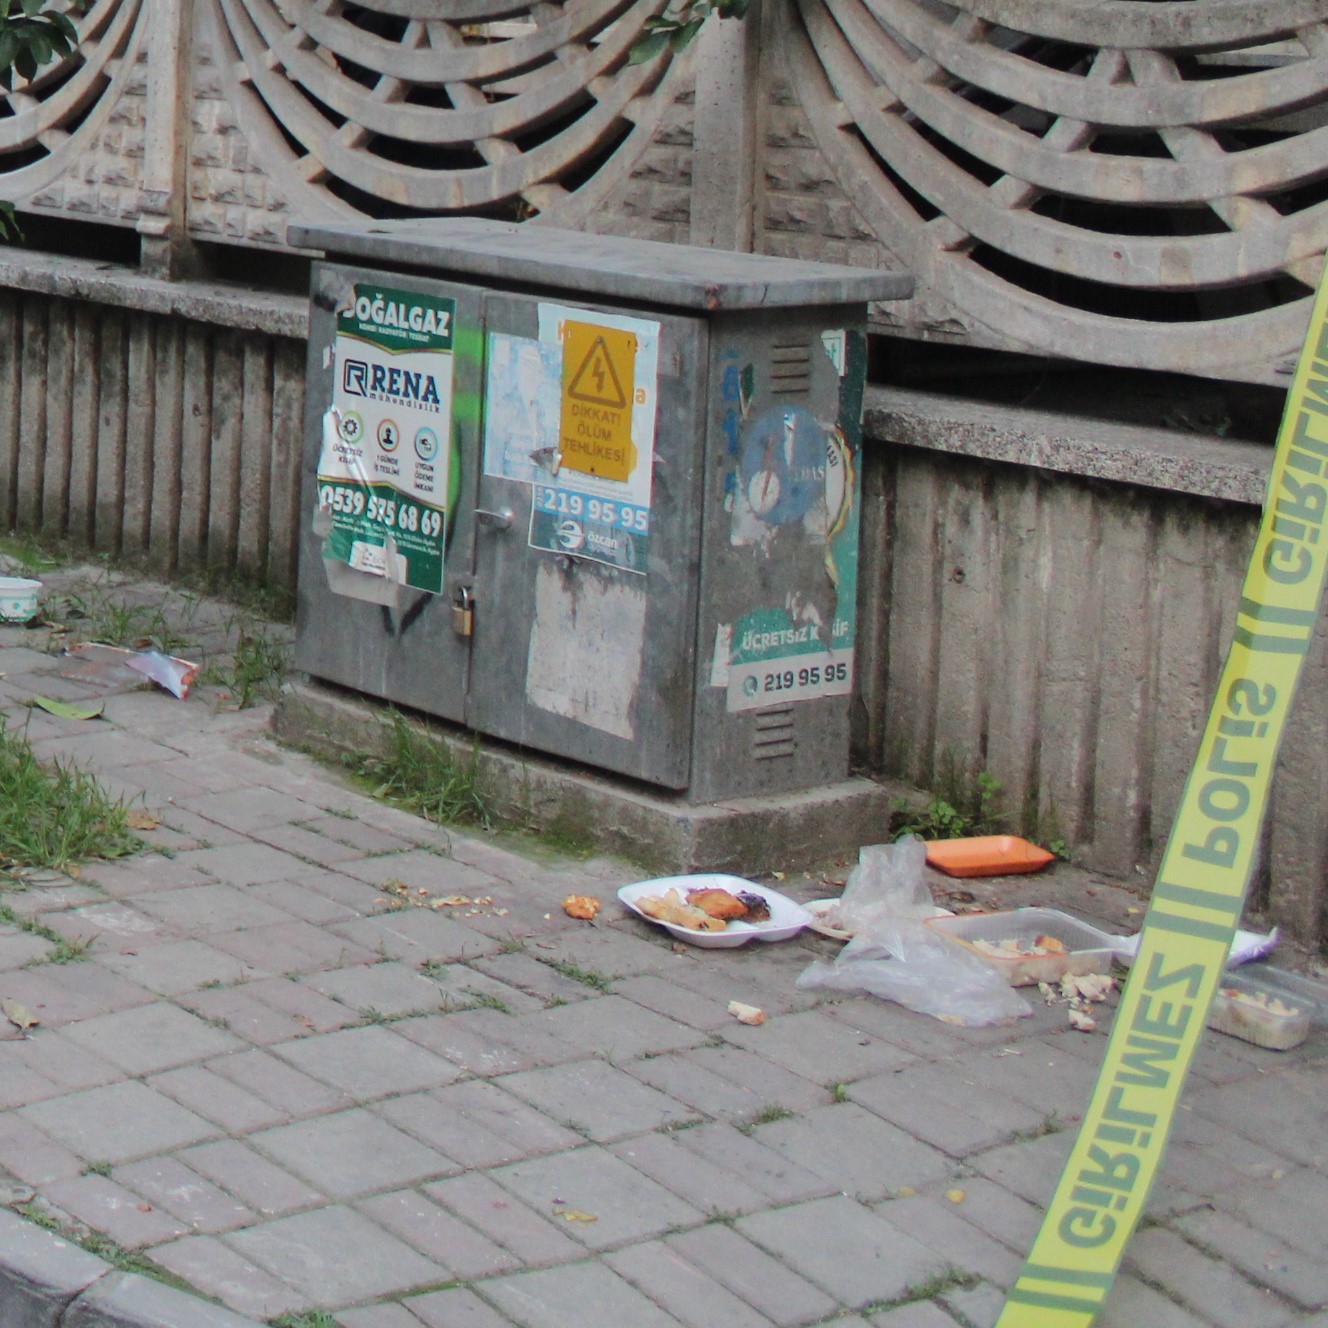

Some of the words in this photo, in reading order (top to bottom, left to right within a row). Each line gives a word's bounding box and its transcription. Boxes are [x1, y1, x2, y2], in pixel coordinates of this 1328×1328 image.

[371, 364, 440, 404] RENA
[577, 423, 612, 442] ÖLÜM
[320, 485, 365, 516] 0539
[398, 503, 419, 532] 68
[421, 510, 442, 538] 69
[544, 488, 584, 516] 219
[588, 499, 618, 524] 95
[620, 506, 649, 531] 95
[587, 530, 618, 548] özcan
[742, 626, 808, 650] ÜCRETSİZ
[764, 671, 794, 692] 219
[798, 667, 821, 687] 95
[824, 662, 847, 683] 95
